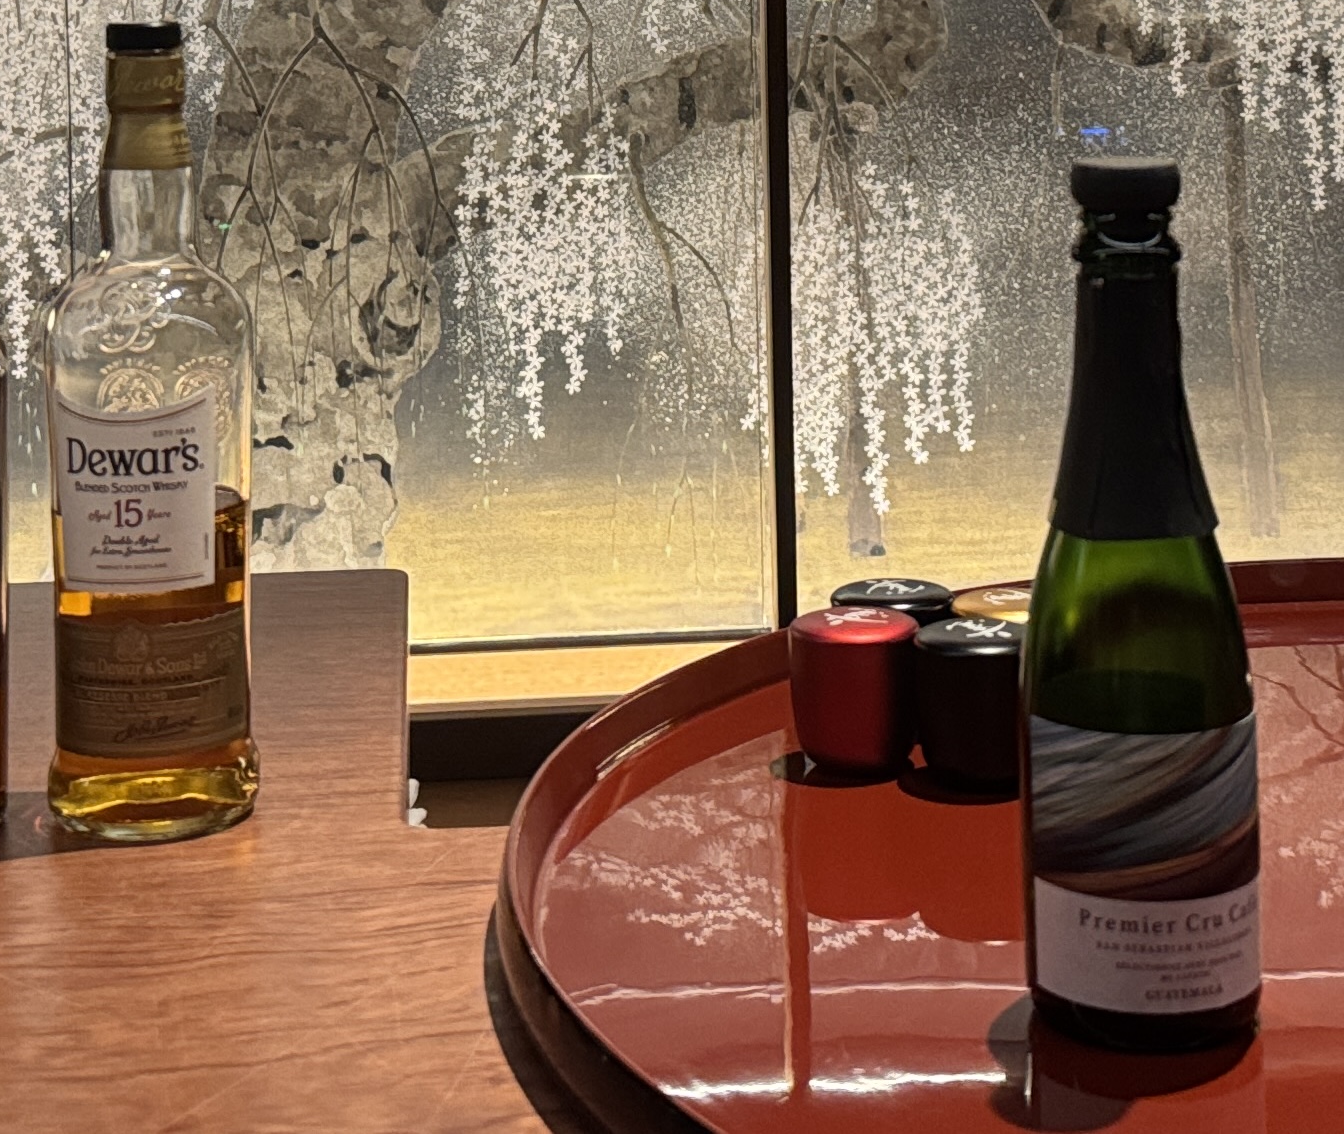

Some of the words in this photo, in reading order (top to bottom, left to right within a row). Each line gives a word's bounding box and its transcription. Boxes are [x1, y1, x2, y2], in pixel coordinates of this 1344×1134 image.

[66, 437, 200, 476] Dewar's
[74, 480, 110, 493] BLENDED
[111, 479, 151, 493] SCOTCH
[153, 480, 189, 492] WHISKY
[113, 499, 144, 528] 15
[1078, 907, 1177, 935] Premier
[1185, 912, 1223, 933] Cru
